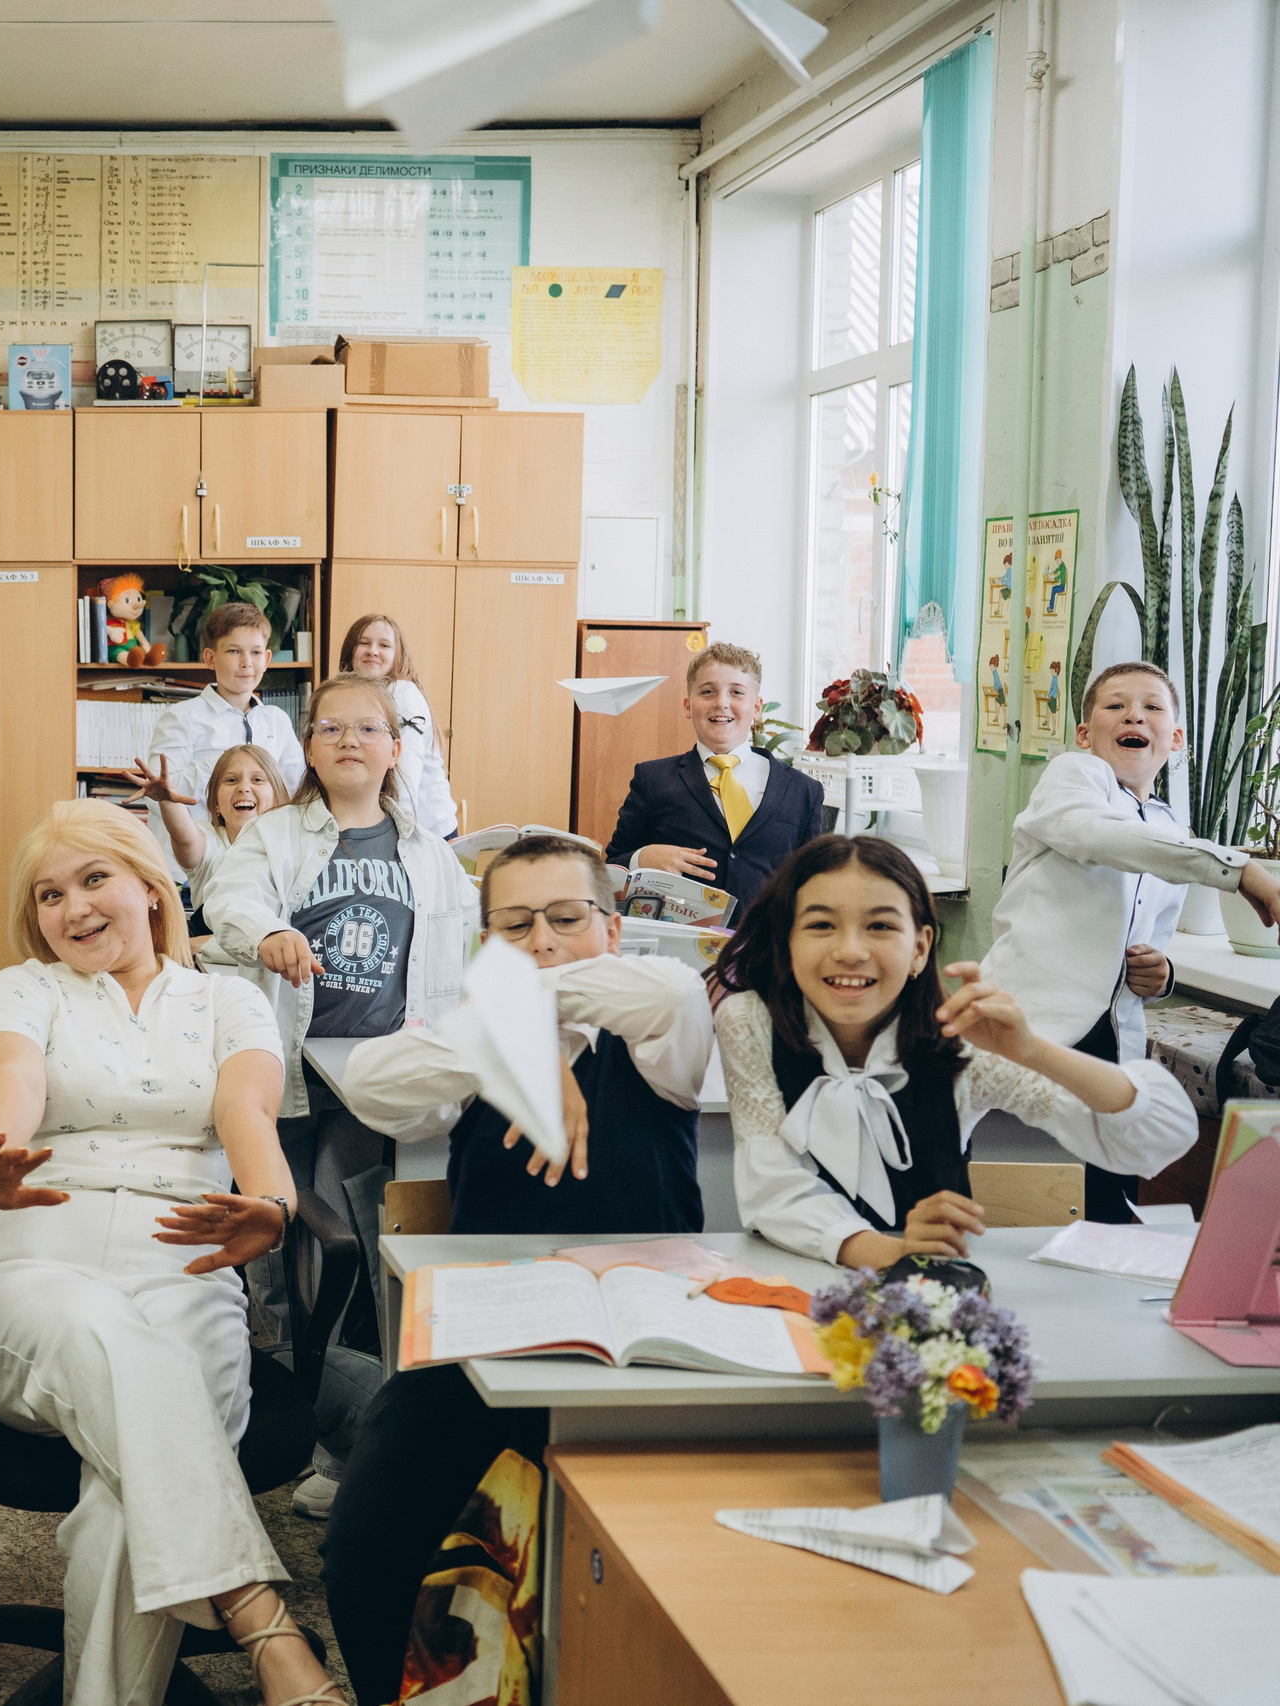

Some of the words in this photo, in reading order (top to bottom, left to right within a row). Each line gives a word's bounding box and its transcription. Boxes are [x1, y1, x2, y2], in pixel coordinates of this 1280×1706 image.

[294, 165, 356, 174] ПРИЗНАКИ
[359, 165, 432, 176] ДЕЛИМОСТИ
[295, 184, 302, 195] 2
[295, 227, 302, 237] 4
[295, 247, 301, 258] 5
[295, 268, 302, 279] 9
[295, 288, 308, 300] 10
[294, 309, 308, 321] 25
[992, 522, 1037, 534] ПРАВАЯ
[1038, 518, 1072, 529] ПОСАДКА
[251, 538, 279, 547] ШКАФ
[998, 538, 1007, 547] ВО
[1032, 532, 1064, 545] ЗАНЯТИЙ
[30, 573, 34, 581] 3
[515, 574, 544, 582] ШКАФ
[294, 859, 415, 913] ALIFORN
[328, 908, 354, 936] DREAM
[359, 907, 384, 927] TEAM
[362, 933, 387, 971] COLLEGE
[328, 946, 357, 972] LEAGUE
[326, 981, 342, 989] GIRL
[346, 984, 370, 993] POWER
[359, 978, 382, 987] NEVER
